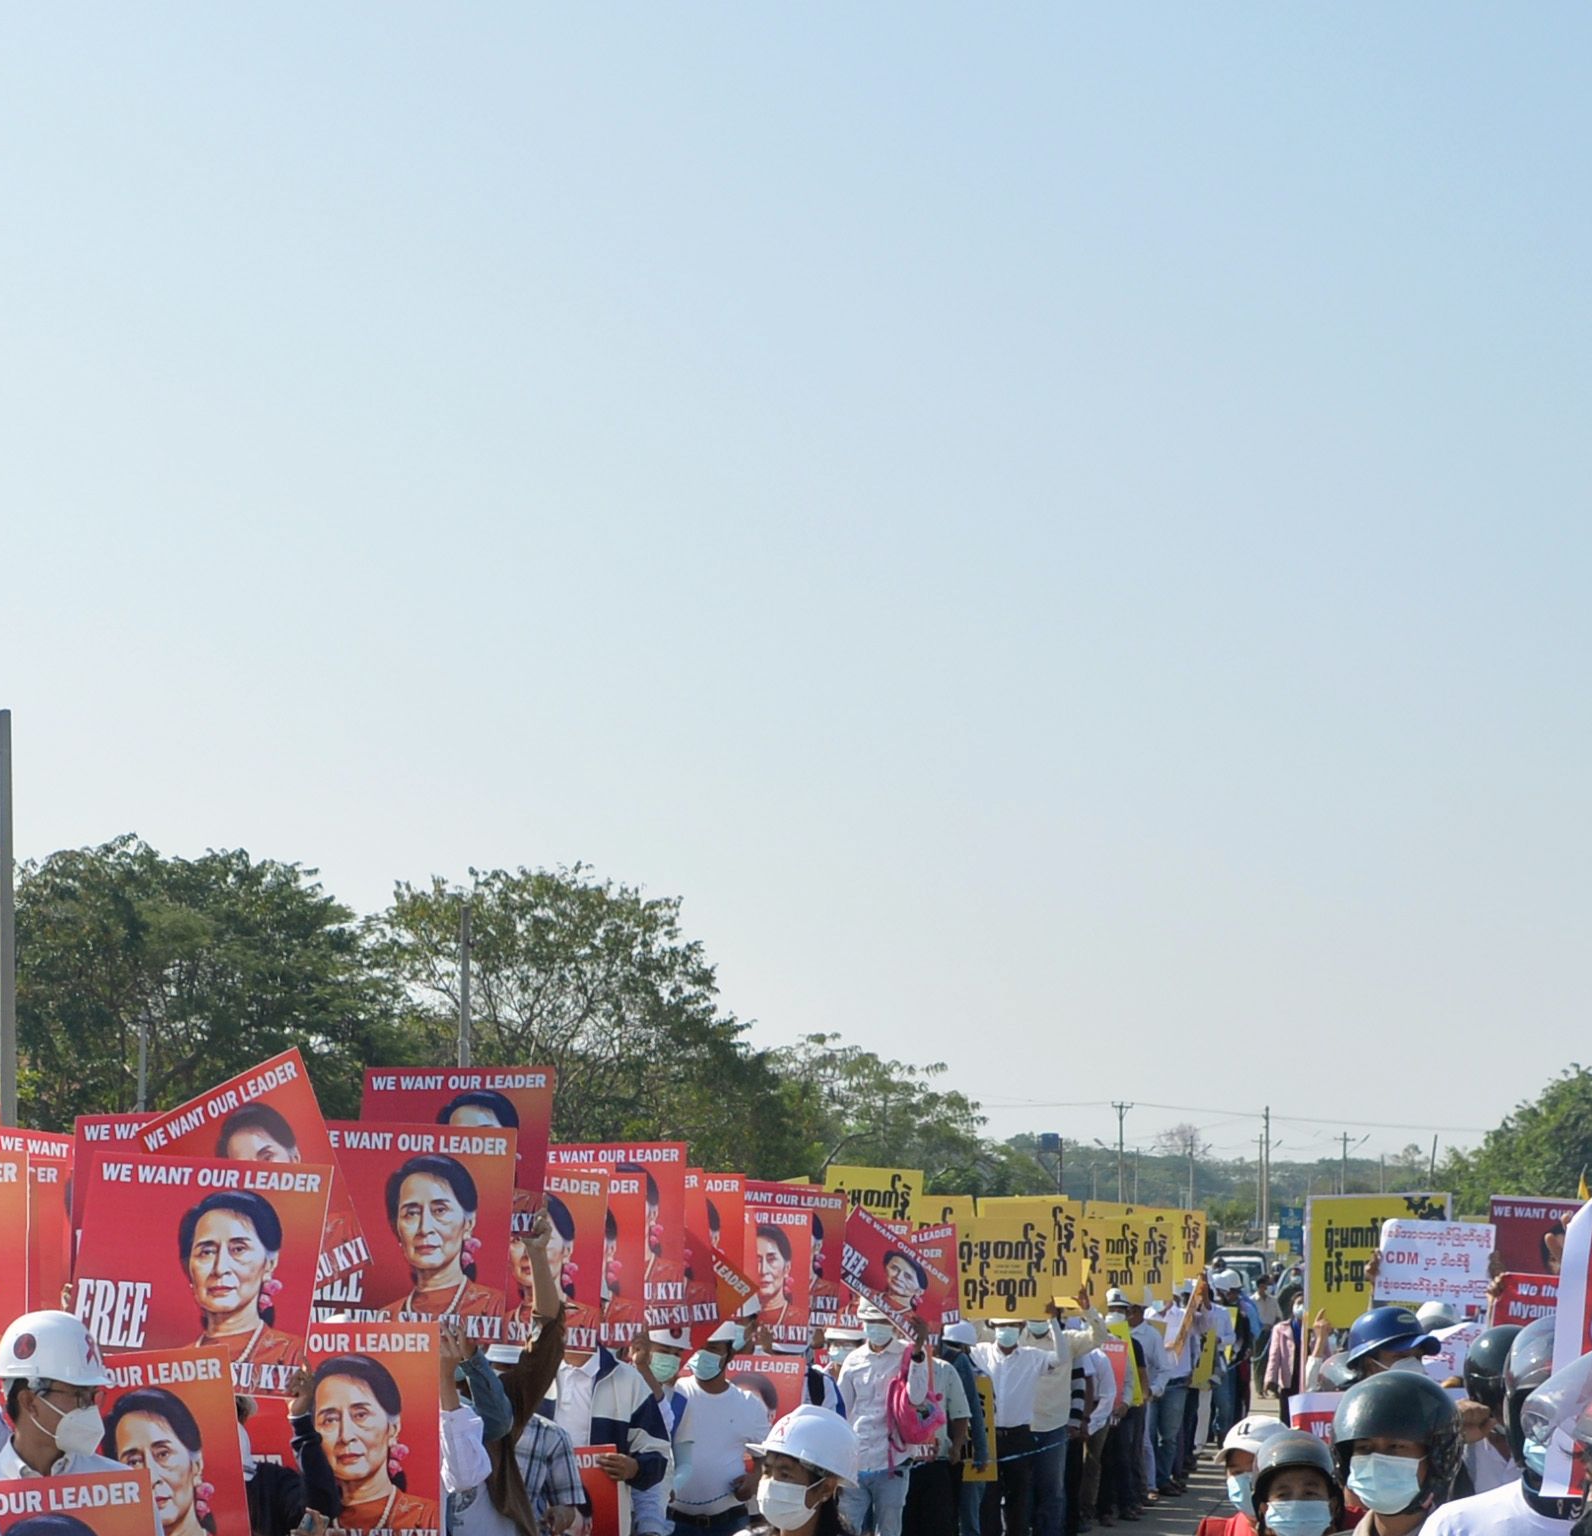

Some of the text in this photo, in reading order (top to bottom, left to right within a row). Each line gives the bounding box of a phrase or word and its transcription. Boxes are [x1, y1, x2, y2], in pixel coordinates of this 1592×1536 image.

[372, 1073, 546, 1091] WE WANT OUR LEADER
[144, 1061, 298, 1152] WE WANT OUR LEADER
[84, 1124, 110, 1141] WE
[0, 1135, 69, 1158] WE WANT
[344, 1132, 507, 1156] WANT OUR LEADER
[560, 1148, 679, 1164] WANT OUR LEADER
[102, 1162, 321, 1193] WE WANT OUR LEADER
[544, 1176, 600, 1195] LEADER
[775, 1193, 842, 1210] OUR LEADER
[770, 1213, 808, 1226] LEADER
[1493, 1205, 1546, 1219] WE WANT
[918, 1227, 953, 1243] LEADER
[333, 1237, 371, 1273] KYI
[858, 1209, 950, 1285] WE WANT OUR LEADER
[1385, 1250, 1419, 1265] CDM
[713, 1261, 750, 1297] LEADER
[845, 1275, 872, 1298] AUNG
[658, 1282, 683, 1299] KYI
[1517, 1283, 1538, 1296] We
[692, 1302, 718, 1321] KYI
[816, 1295, 839, 1311] KYI
[75, 1278, 152, 1348] FREE
[810, 1312, 837, 1326] AUNG
[466, 1315, 502, 1340] KYI
[788, 1325, 808, 1341] KYI
[309, 1332, 430, 1353] OUR LEADER
[568, 1327, 596, 1348] KYI
[148, 1358, 222, 1384] LEADER
[727, 1360, 800, 1374] OUR LEADER
[48, 1481, 140, 1511] LEADER
